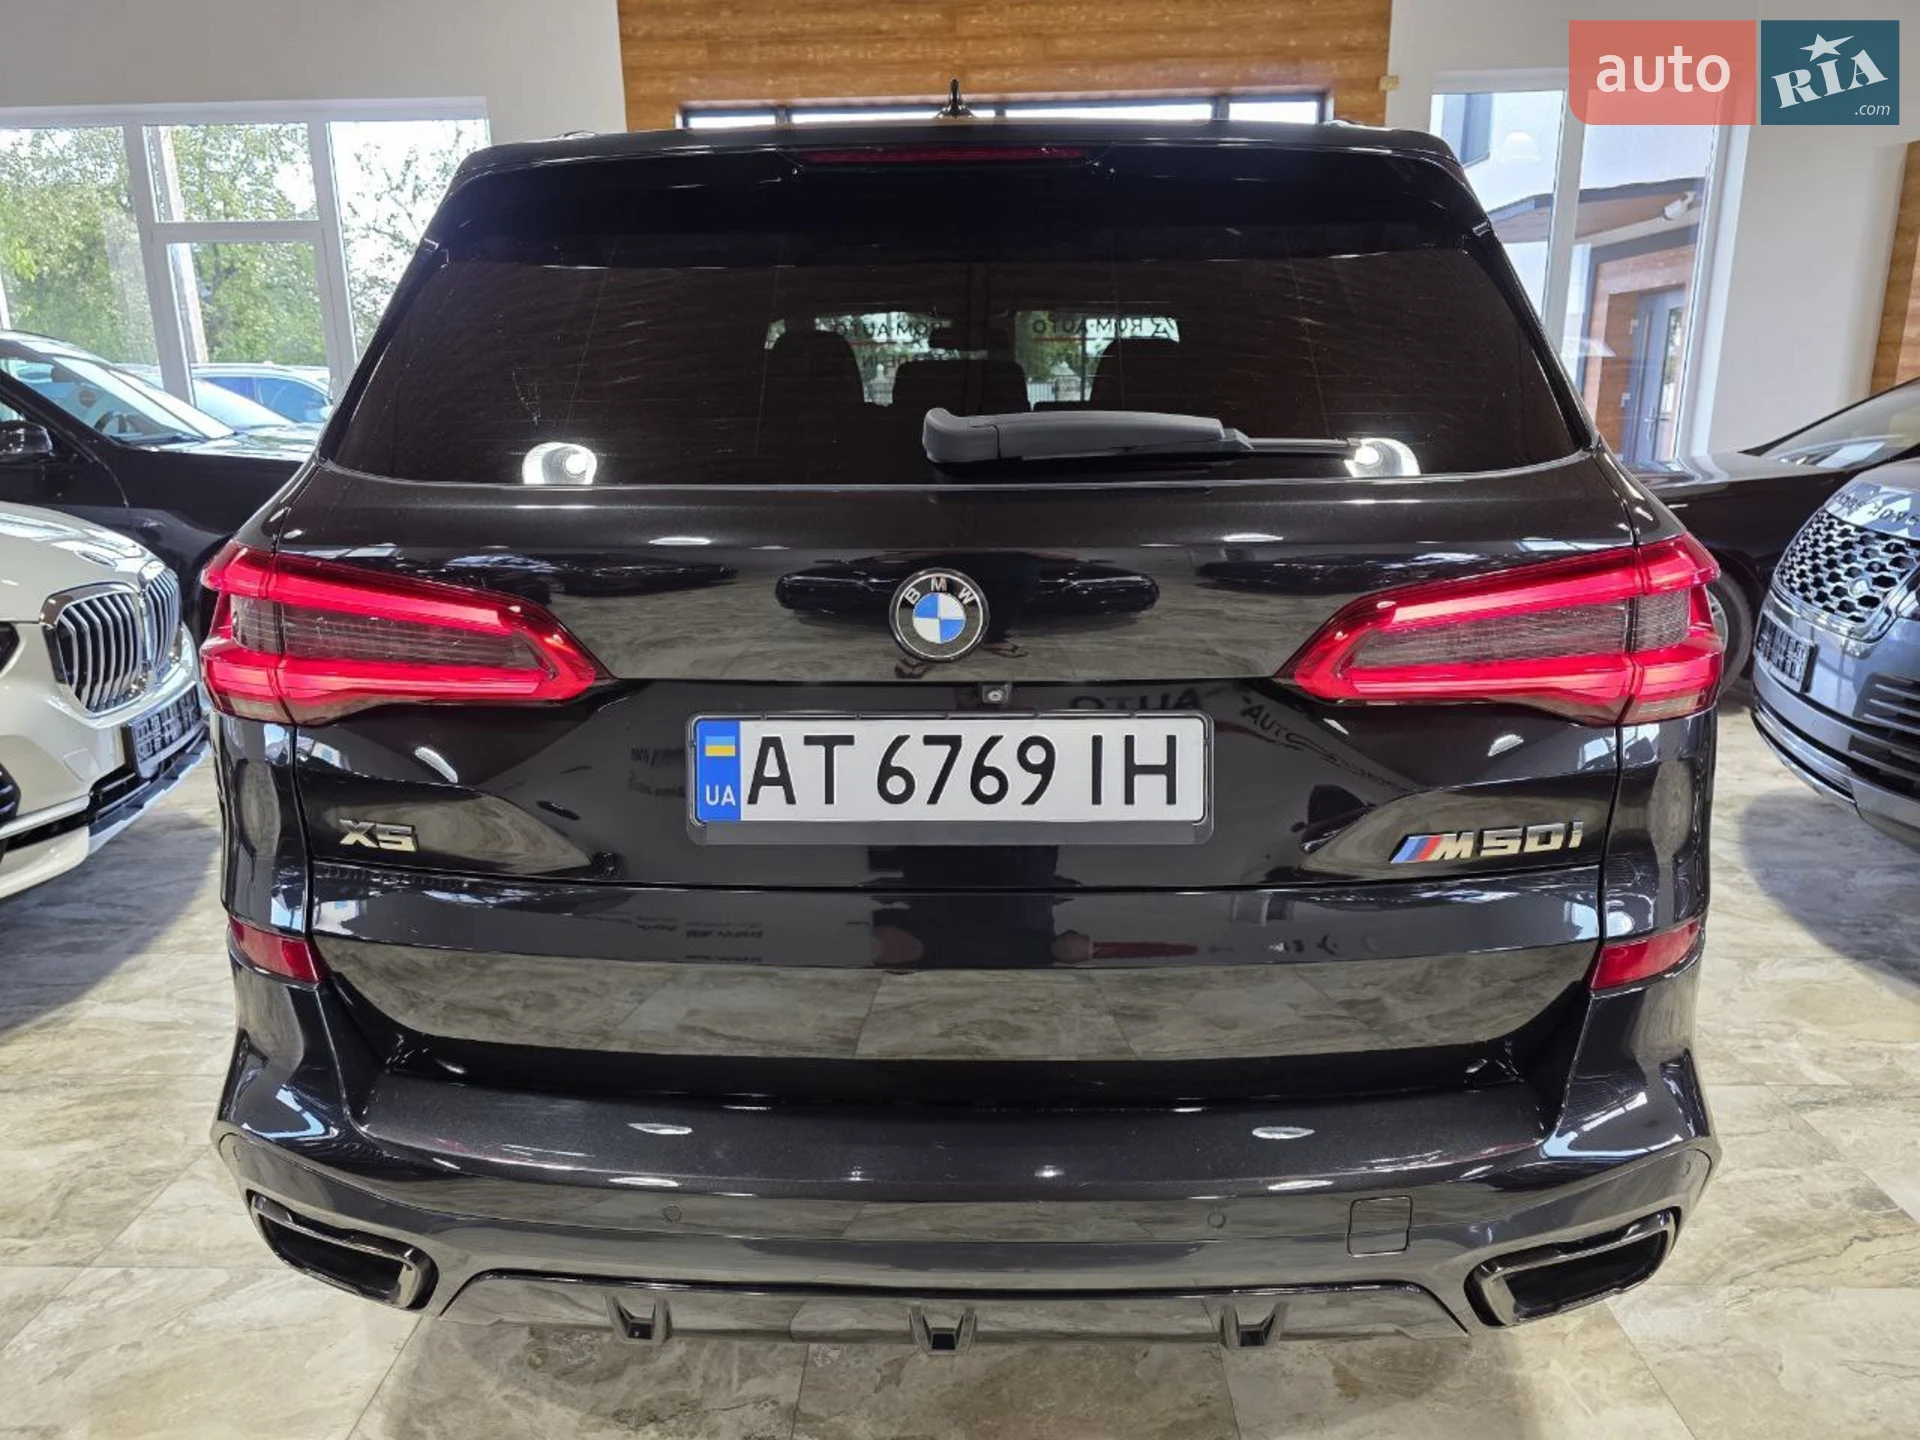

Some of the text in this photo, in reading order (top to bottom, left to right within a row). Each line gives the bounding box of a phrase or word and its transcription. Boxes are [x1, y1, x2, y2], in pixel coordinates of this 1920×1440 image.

[904, 577, 976, 605] BMW
[747, 734, 855, 805] AT
[877, 734, 1057, 805] 6769
[1091, 734, 1177, 805] IH
[705, 785, 736, 806] UA
[340, 819, 416, 852] X5
